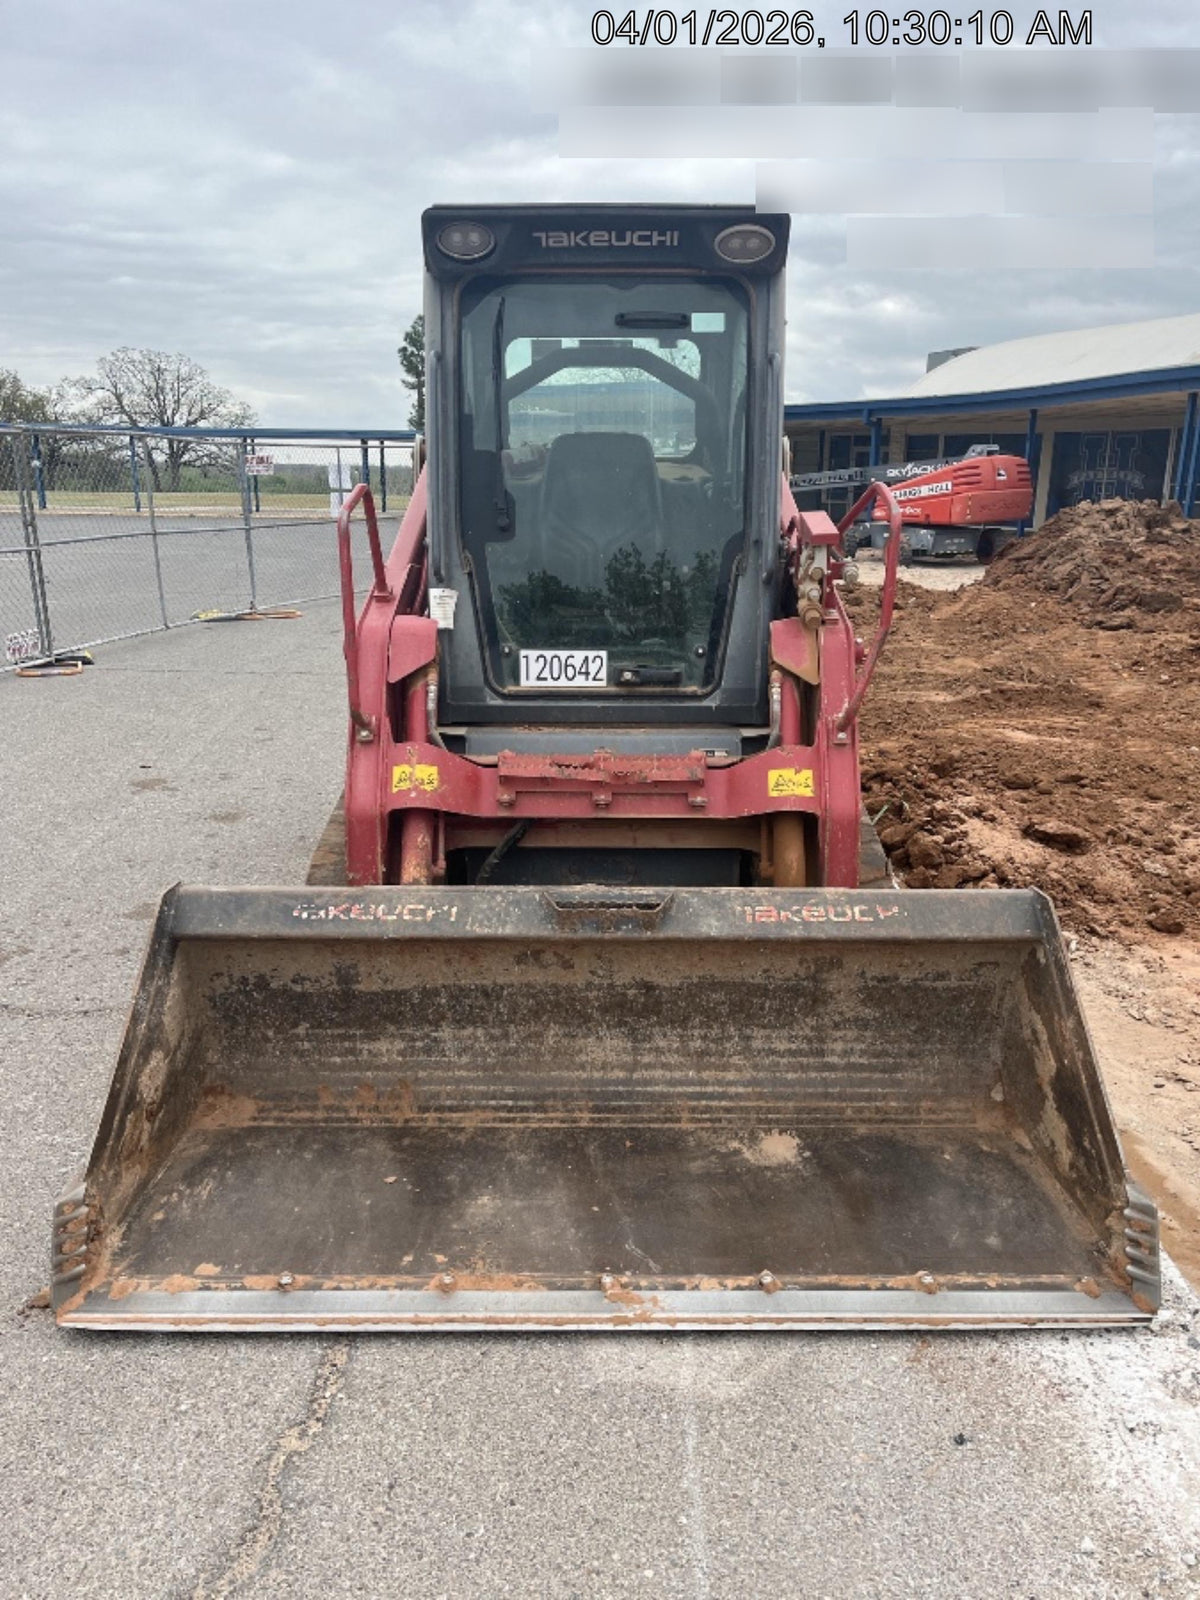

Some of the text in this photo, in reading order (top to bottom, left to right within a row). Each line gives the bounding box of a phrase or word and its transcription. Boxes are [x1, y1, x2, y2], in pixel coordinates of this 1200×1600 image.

[532, 230, 679, 248] TAKEUCHI
[886, 462, 935, 478] SKYJACK
[522, 654, 604, 681] 120642
[737, 904, 909, 923] TAKEUC
